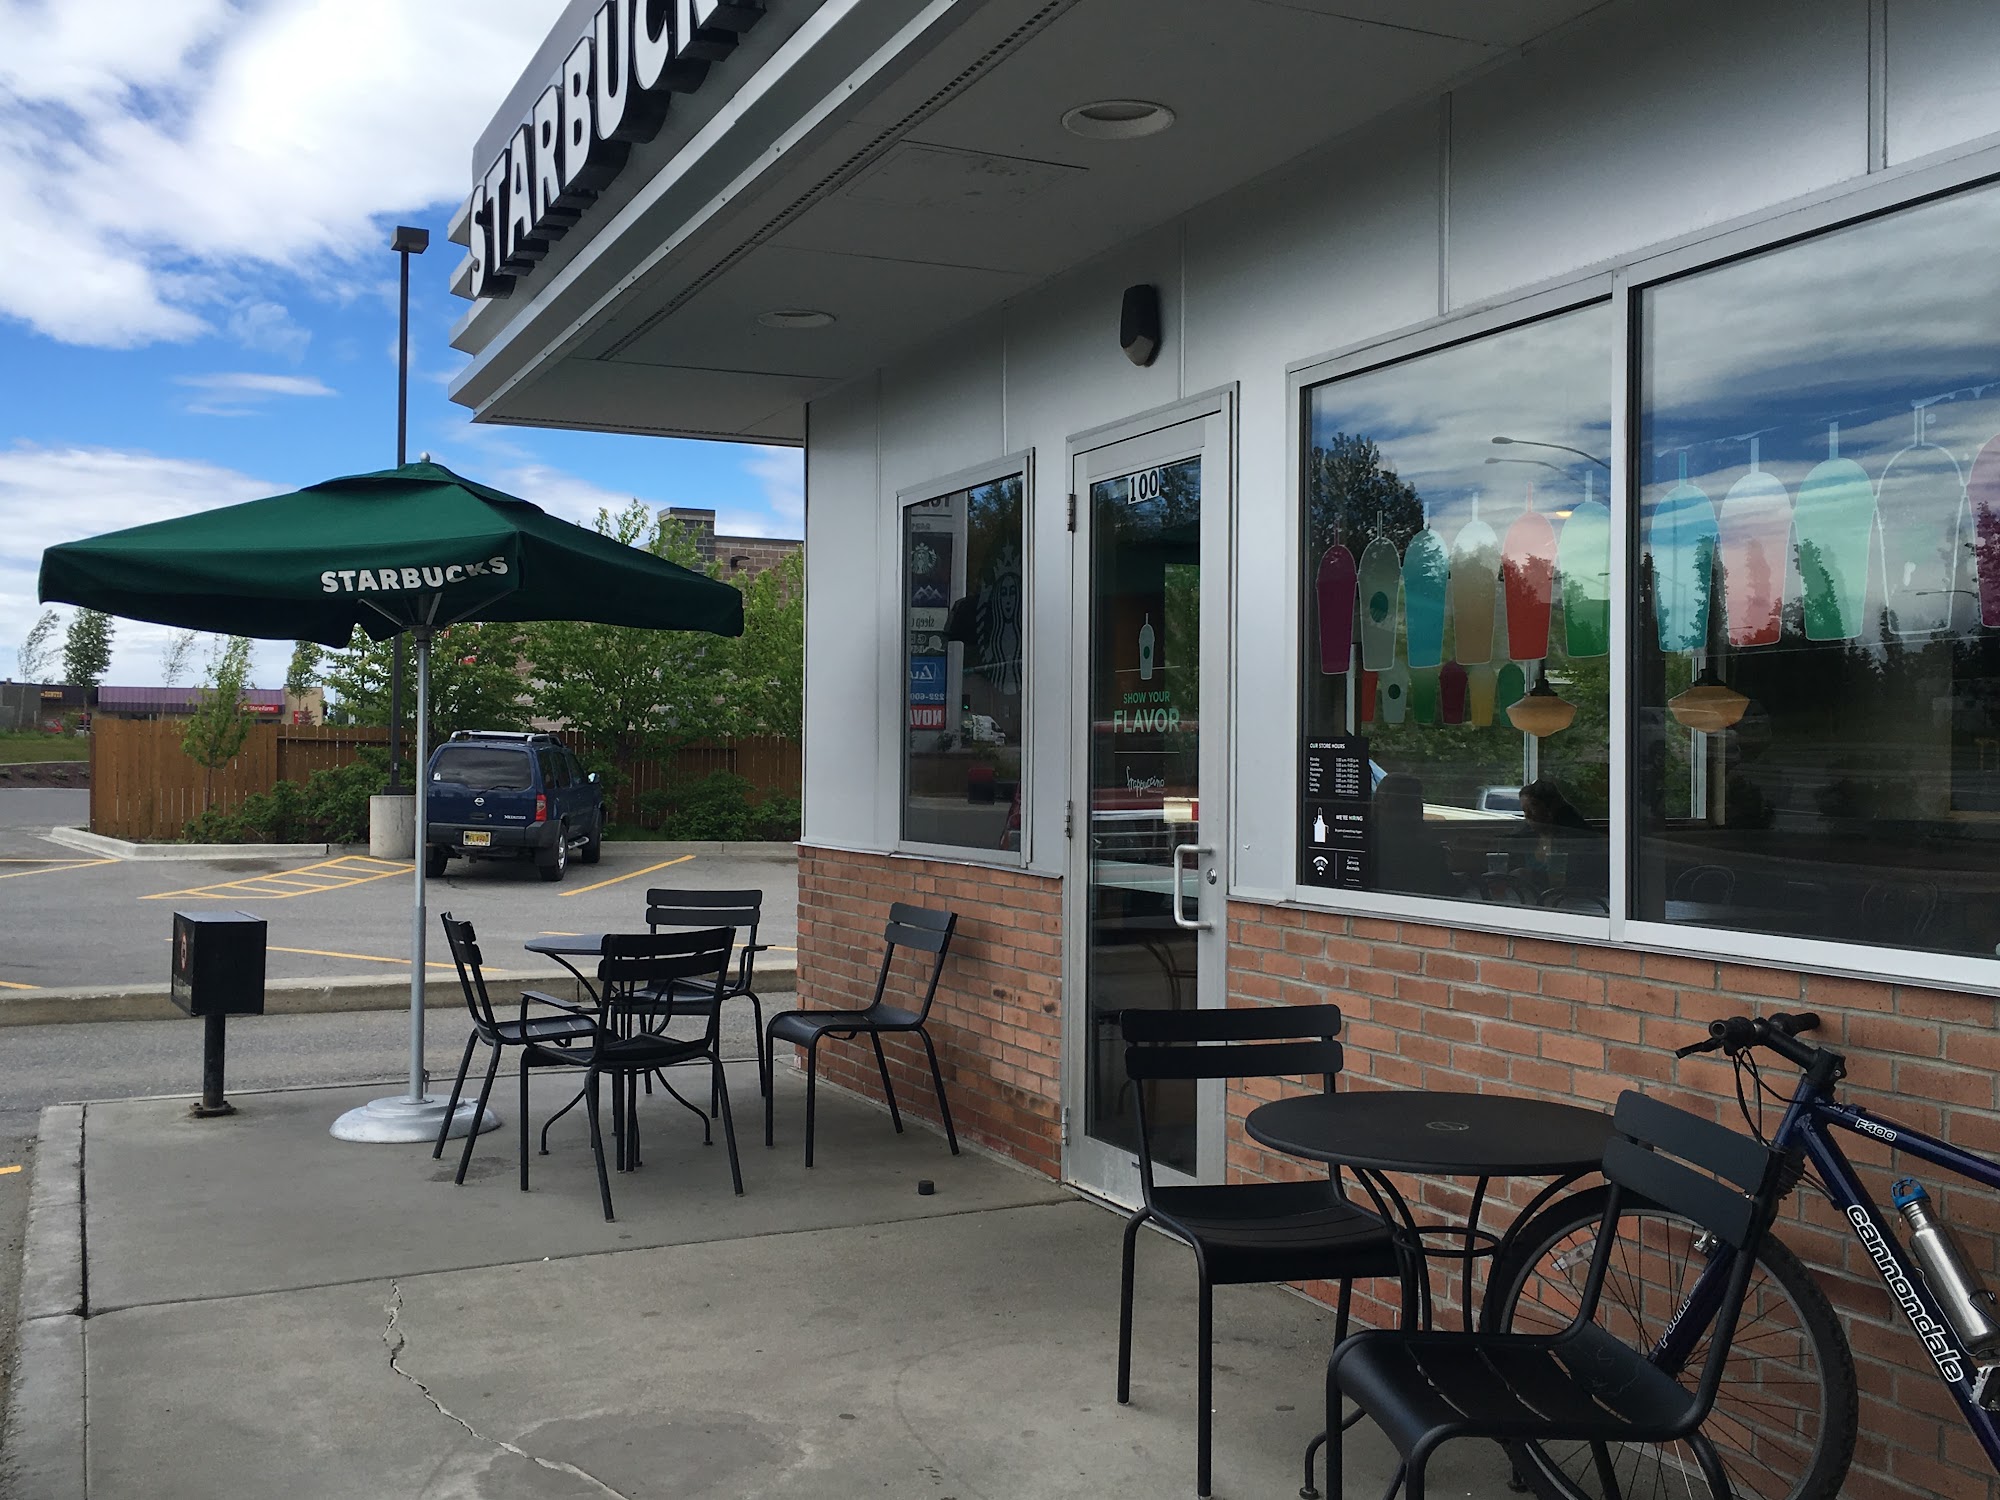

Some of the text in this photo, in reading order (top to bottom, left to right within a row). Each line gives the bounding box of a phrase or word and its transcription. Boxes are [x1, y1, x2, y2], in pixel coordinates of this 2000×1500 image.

[1130, 469, 1158, 502] 100
[320, 556, 509, 593] STARBUCKS
[1123, 691, 1170, 704] SHOW YOUR
[1113, 708, 1180, 733] FLAVOR
[1855, 1118, 1897, 1142] F400
[1847, 1204, 1964, 1382] cannondale
